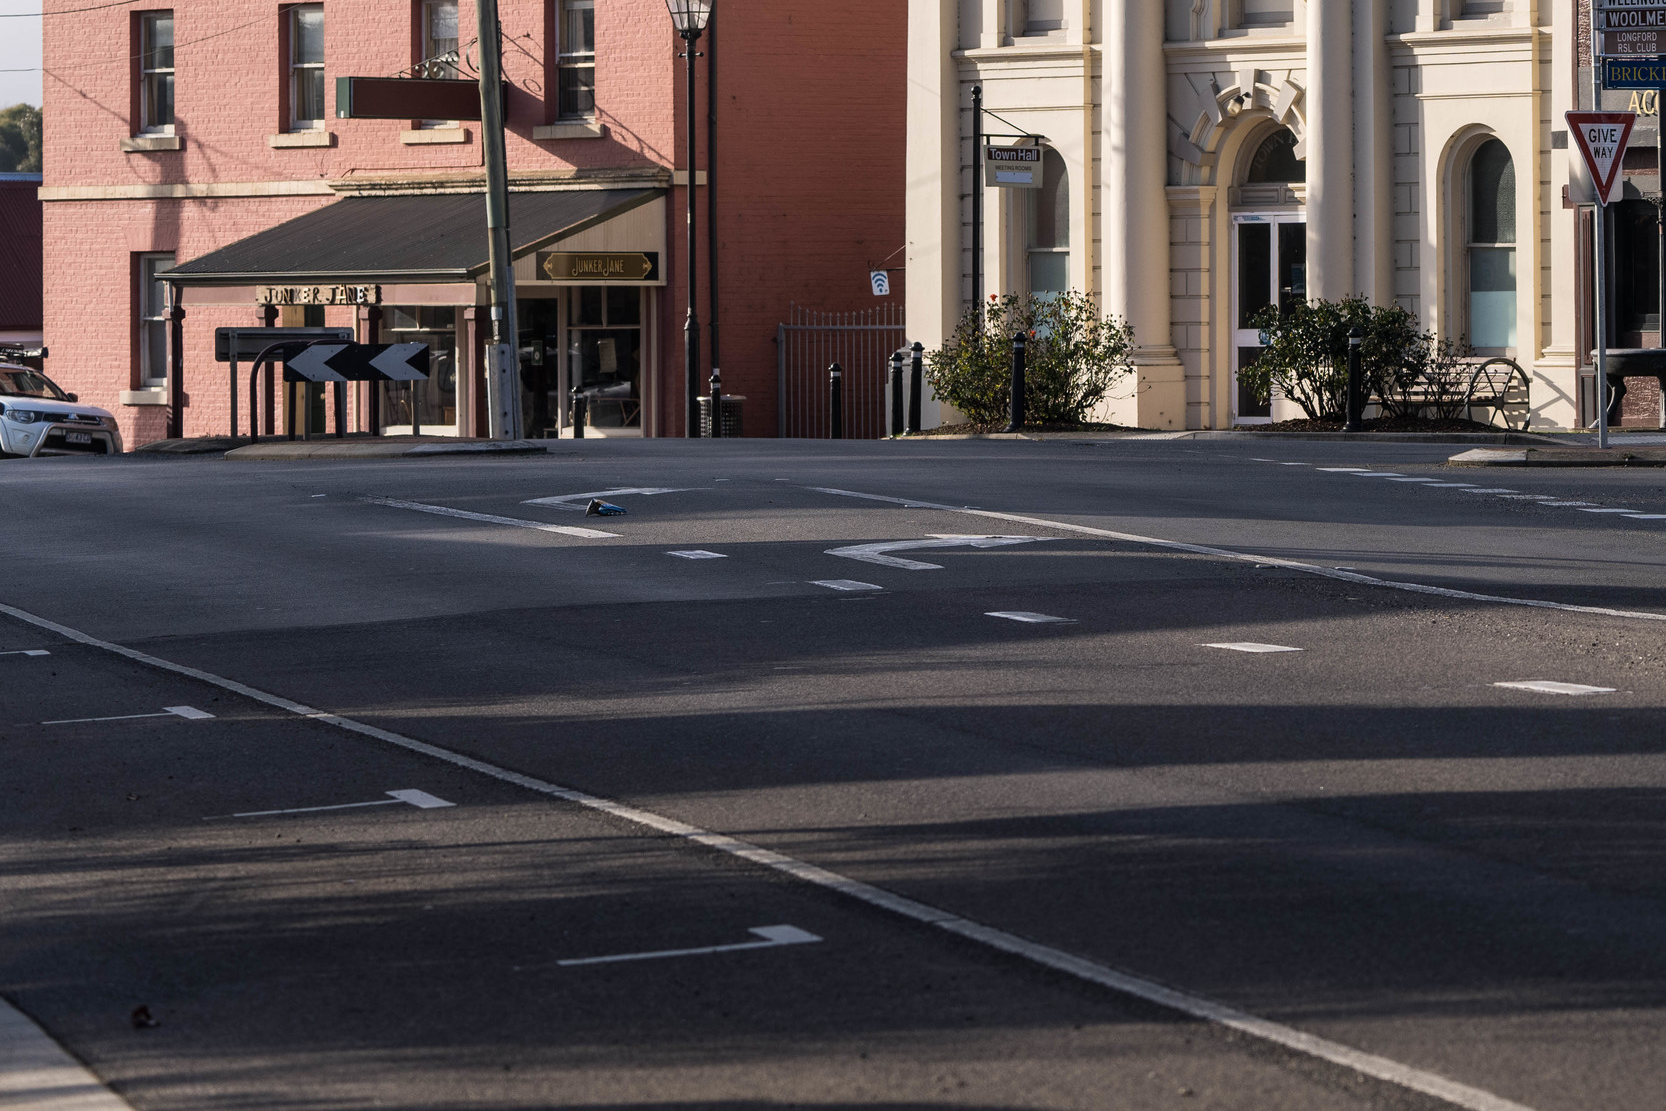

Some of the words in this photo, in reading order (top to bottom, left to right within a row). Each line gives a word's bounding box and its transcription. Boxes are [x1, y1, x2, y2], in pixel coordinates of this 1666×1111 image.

[1617, 32, 1658, 42] LONGFORD
[1617, 43, 1633, 53] RSL
[1636, 43, 1657, 53] CLUB
[1588, 128, 1617, 143] GIVE
[990, 148, 1017, 160] Town
[1018, 149, 1037, 161] Hall
[1593, 146, 1614, 158] WAY
[264, 287, 323, 303] JUNKER
[325, 284, 366, 305] JANE
